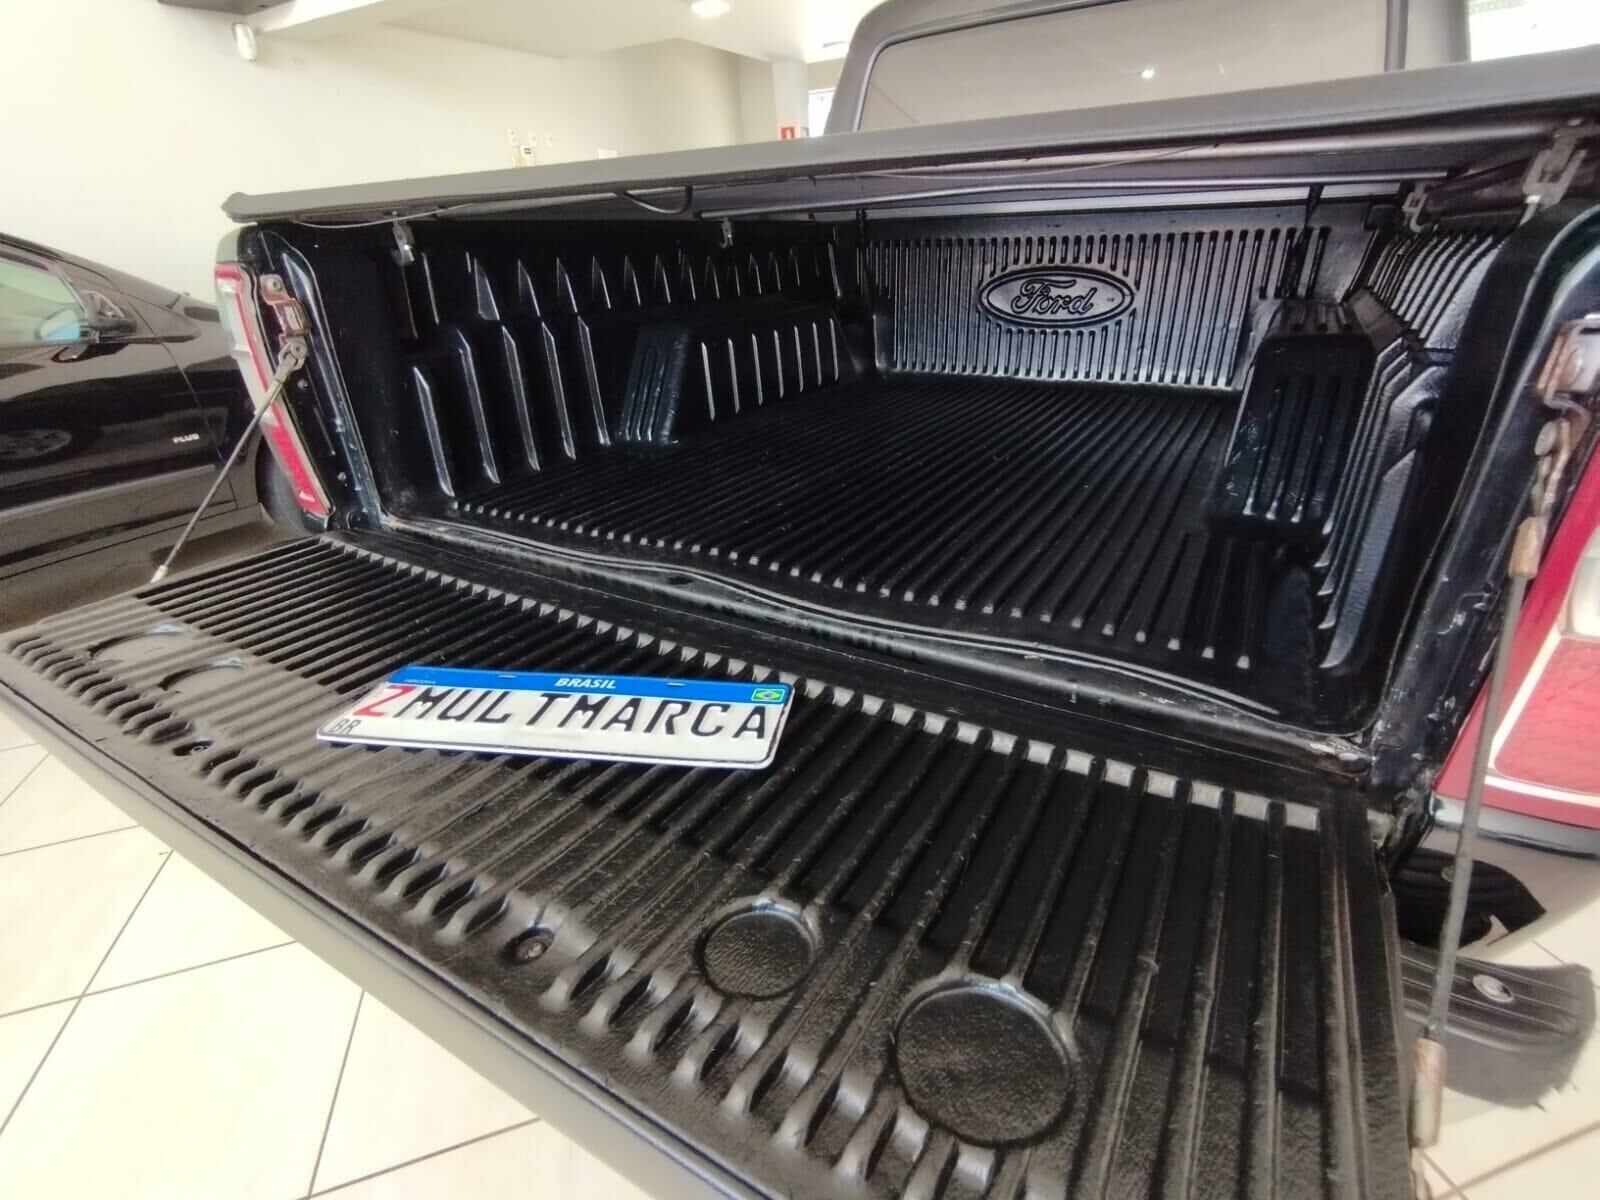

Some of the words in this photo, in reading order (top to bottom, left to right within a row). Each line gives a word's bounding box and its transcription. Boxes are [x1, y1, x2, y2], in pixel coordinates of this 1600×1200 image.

[1011, 278, 1097, 315] Ford
[172, 433, 199, 443] PLUS
[555, 678, 616, 689] BRASIL
[330, 718, 362, 734] BR
